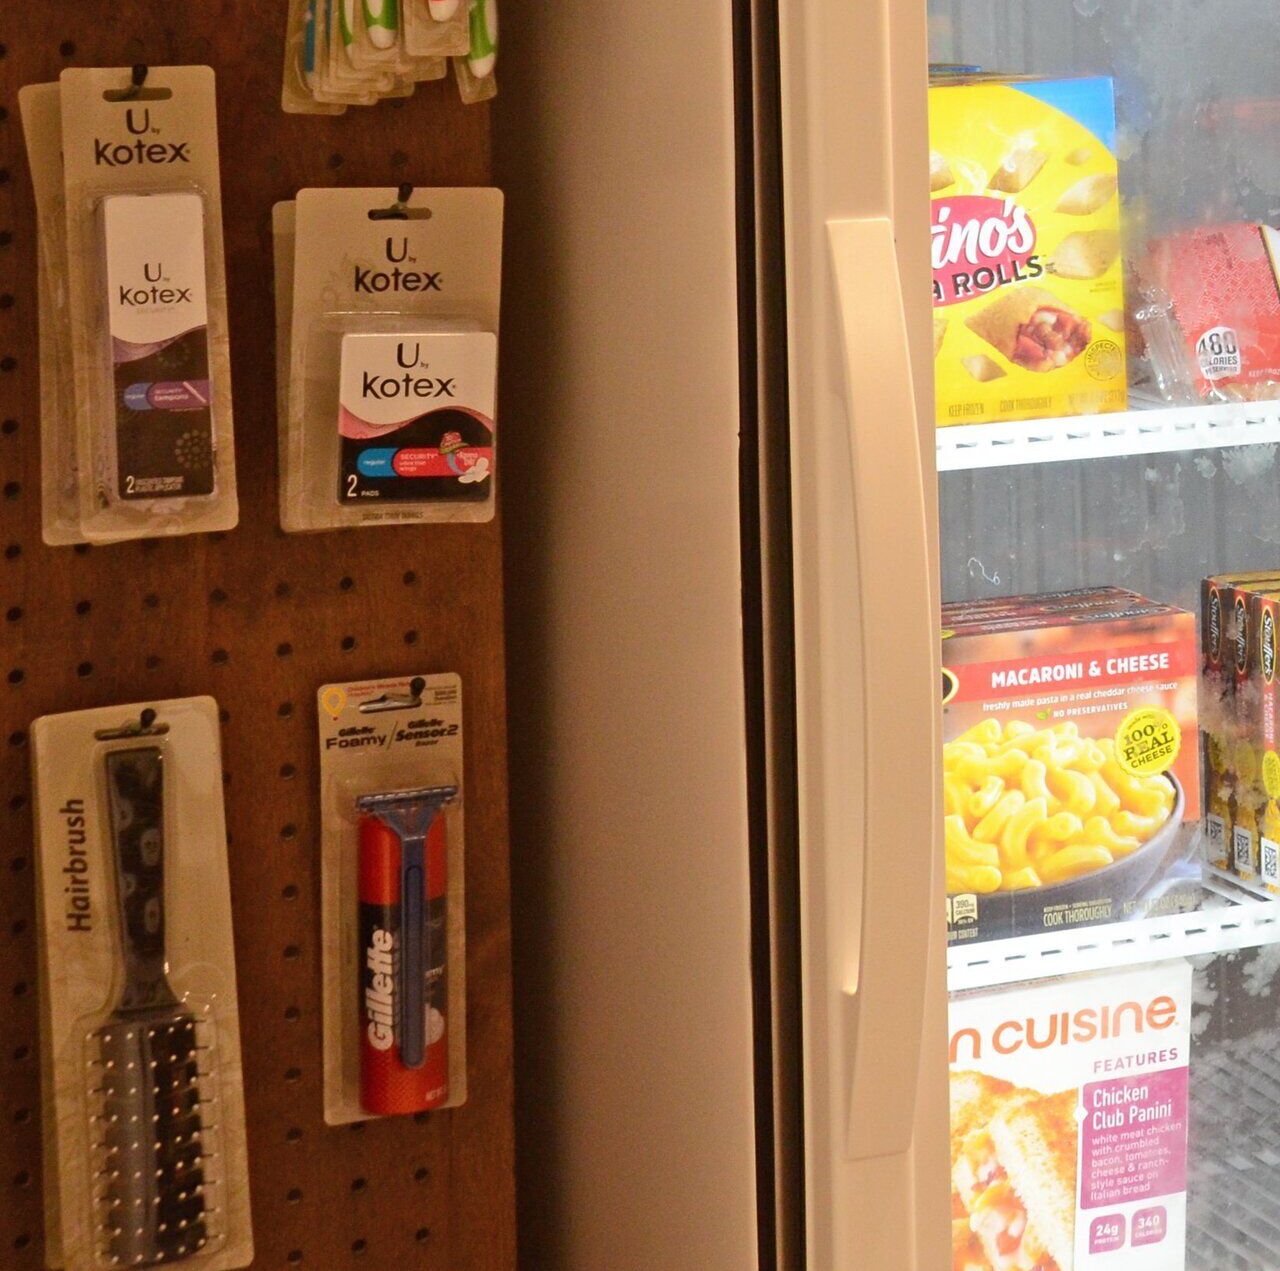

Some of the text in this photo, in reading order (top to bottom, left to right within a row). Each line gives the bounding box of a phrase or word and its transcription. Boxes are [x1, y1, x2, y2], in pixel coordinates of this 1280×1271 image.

[126, 108, 149, 134] U
[94, 139, 190, 166] kotex
[385, 237, 408, 263] U
[143, 263, 162, 282] U
[354, 266, 442, 293] kotex
[954, 255, 1044, 295] ROLLS
[119, 285, 191, 306] kotex
[397, 342, 420, 369] U
[362, 371, 455, 400] kotex
[126, 475, 135, 494] 2
[347, 474, 358, 498] 2
[991, 653, 1169, 689] MACARONI & CHEESE
[983, 687, 1125, 712] freshly made pasta real cheddar
[1053, 703, 1128, 718] NO PRESERVATIVES
[326, 735, 387, 750] Foamy
[1130, 745, 1173, 769] CHEESE
[60, 799, 91, 931] Hairbrush
[1043, 905, 1113, 927] COOK THOROUGHLY
[366, 929, 393, 1050] Gillette
[1094, 1047, 1178, 1074] FEATURES
[1093, 1085, 1149, 1108] Chicken
[1093, 1099, 1172, 1130] Club Panini
[1092, 1121, 1181, 1145] white meat chicken
[1092, 1136, 1160, 1156] with crumbled
[1091, 1163, 1136, 1178] cheese &
[1096, 1224, 1119, 1240] 24g
[1137, 1215, 1160, 1230] 340
